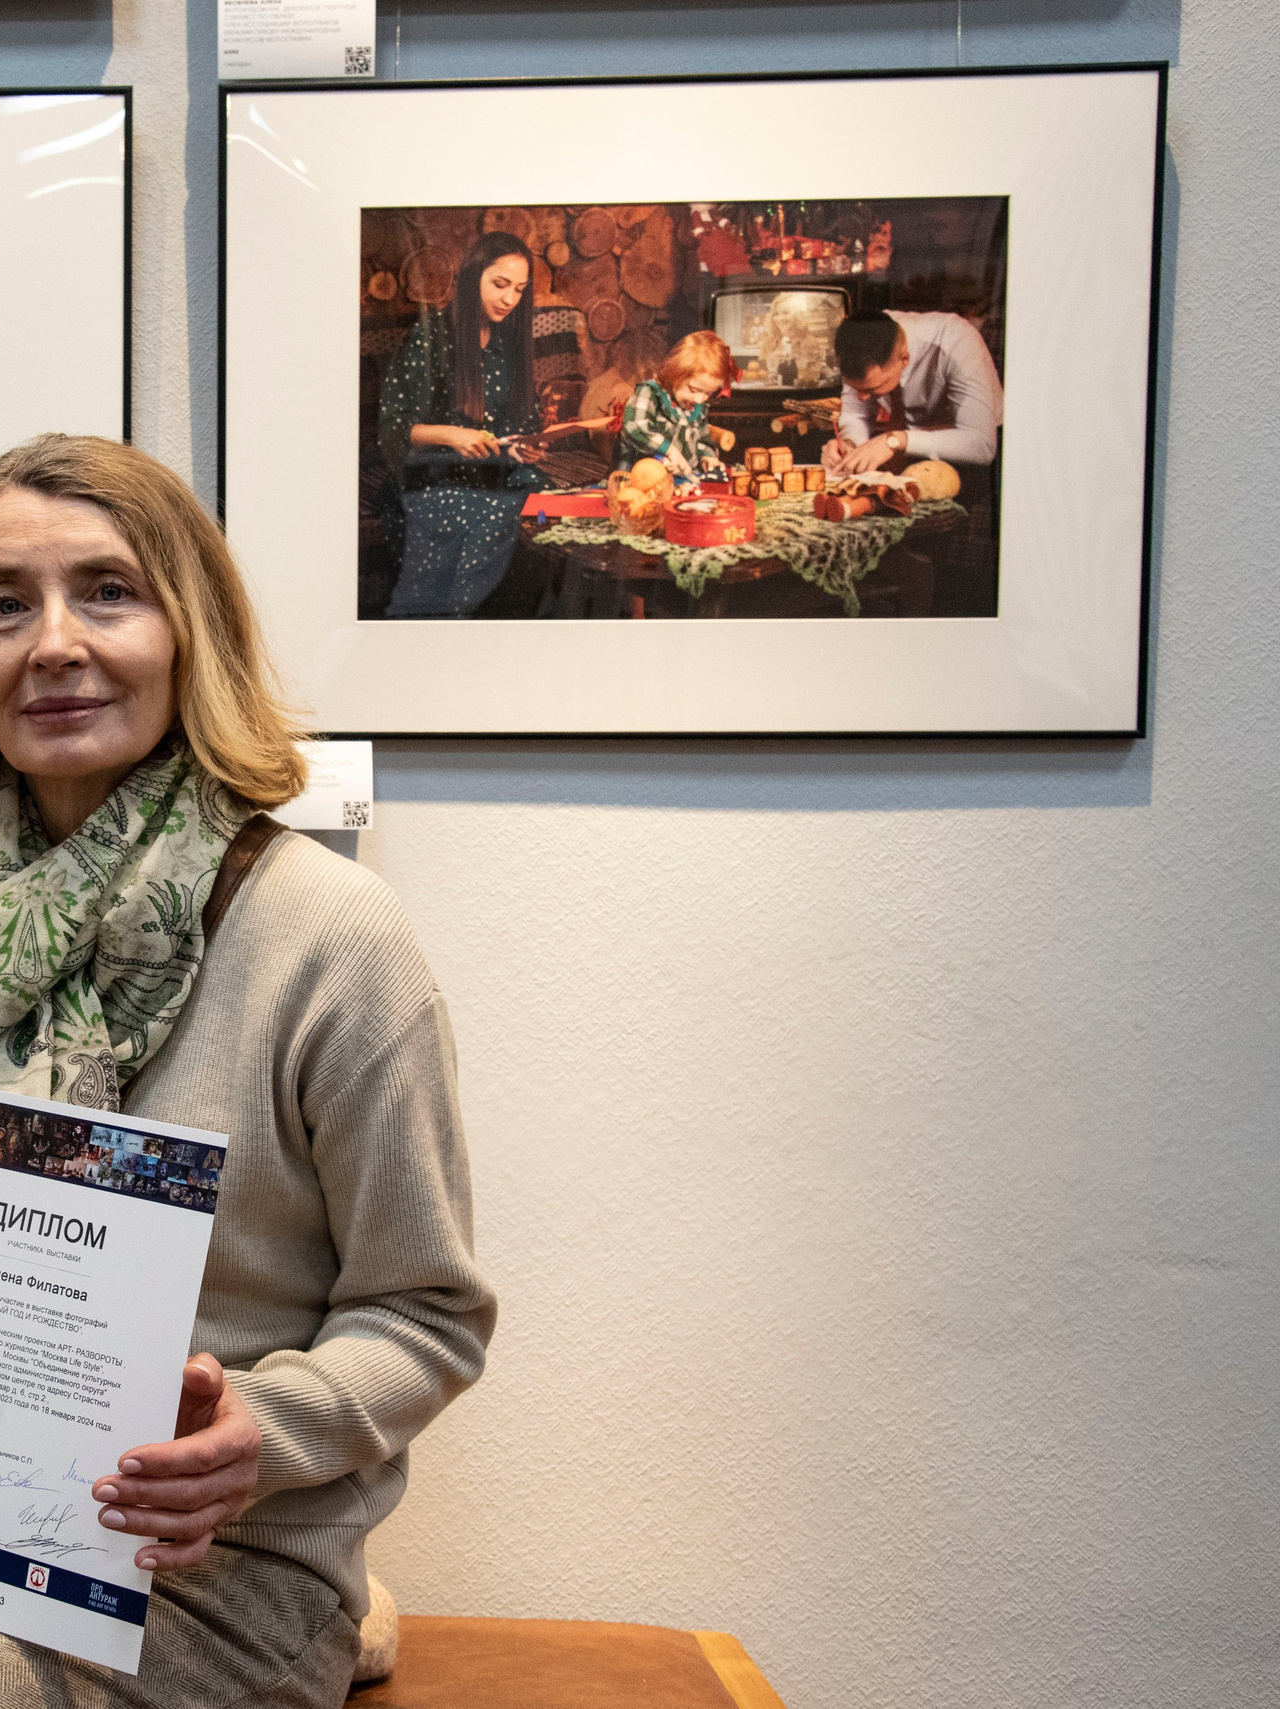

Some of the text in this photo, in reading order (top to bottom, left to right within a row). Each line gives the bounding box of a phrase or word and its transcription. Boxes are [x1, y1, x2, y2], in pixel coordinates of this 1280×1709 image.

[7, 1239, 81, 1263] УЧАСТНИКА ВЫСТАВКИ
[26, 1275, 88, 1302] Филатова
[9, 1308, 24, 1320] ГОД
[24, 1312, 31, 1320] И
[31, 1304, 63, 1318] выставке
[64, 1311, 108, 1329] фотографий
[3, 1341, 39, 1355] журналом
[68, 1357, 82, 1368] Life
[23, 1335, 56, 1349] проектом
[75, 1347, 123, 1367] РАЗВОРОТЫ
[2, 1350, 29, 1364] Москвы
[80, 1373, 122, 1389] культурных
[13, 1365, 81, 1389] административного
[11, 1376, 36, 1388] центре
[36, 1383, 46, 1391] по
[46, 1385, 72, 1399] адресу
[72, 1391, 111, 1409] Страстной
[13, 1399, 30, 1409] года
[30, 1403, 40, 1412] по
[41, 1405, 50, 1414] 18
[50, 1409, 76, 1422] января
[76, 1415, 94, 1427] 2024
[95, 1421, 113, 1432] года.
